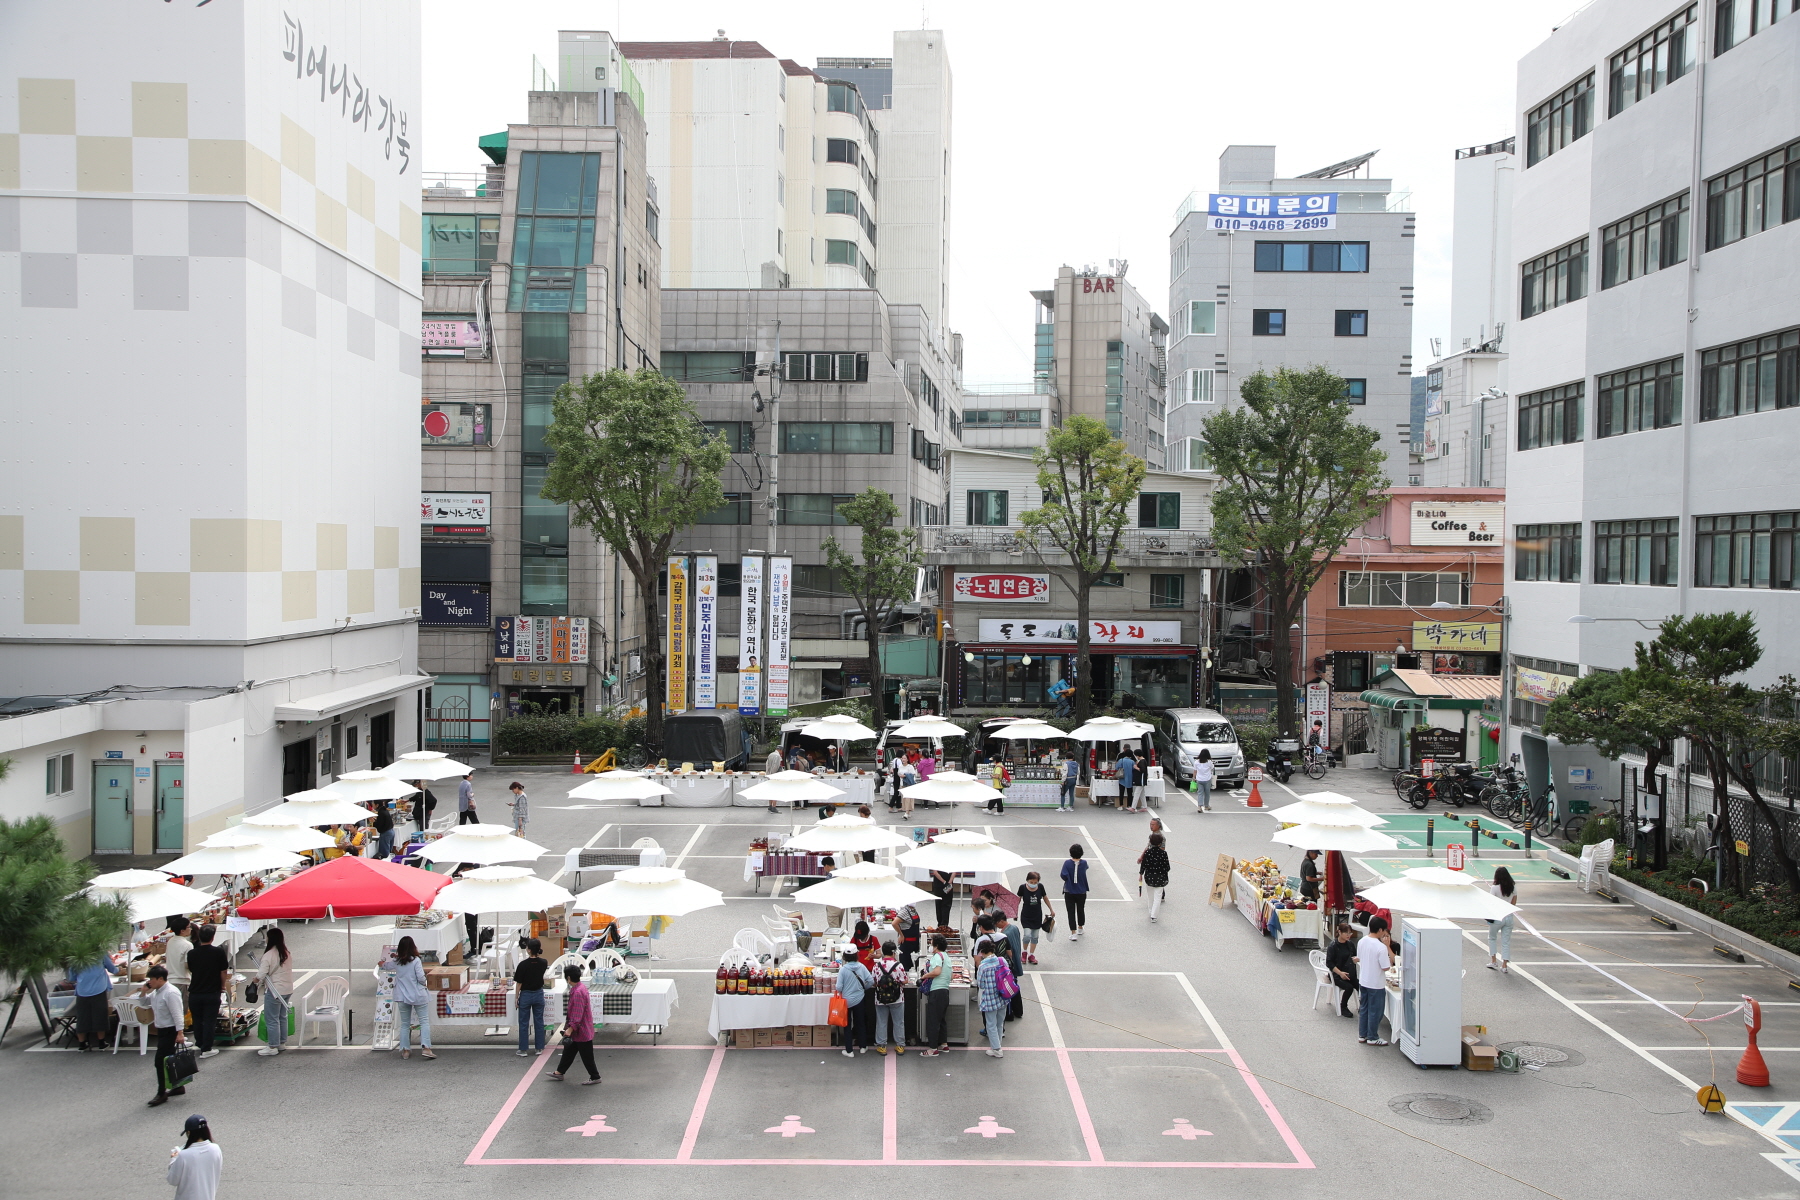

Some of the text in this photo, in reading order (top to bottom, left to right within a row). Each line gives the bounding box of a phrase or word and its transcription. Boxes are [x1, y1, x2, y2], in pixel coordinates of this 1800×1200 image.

[283, 10, 410, 175] 피어나라 강북
[1216, 196, 1330, 216] 임대문의
[1214, 216, 1329, 231] 010-9468-2699
[1083, 278, 1116, 294] BAR
[1431, 520, 1488, 531] Coffee &
[1468, 531, 1495, 542] Beer
[674, 581, 683, 603] 강북구
[773, 573, 781, 593] 재산세
[429, 590, 447, 601] Day
[747, 586, 758, 605] 한국
[447, 606, 473, 618] Night
[746, 606, 757, 634] 문화와
[1000, 623, 1036, 641] 독도
[500, 631, 510, 654] 낮밤
[516, 640, 531, 648] 회전
[556, 629, 568, 660] 마사지
[746, 636, 756, 655] 역사
[673, 654, 682, 668] 개최
[513, 669, 572, 683] 태광빌딩
